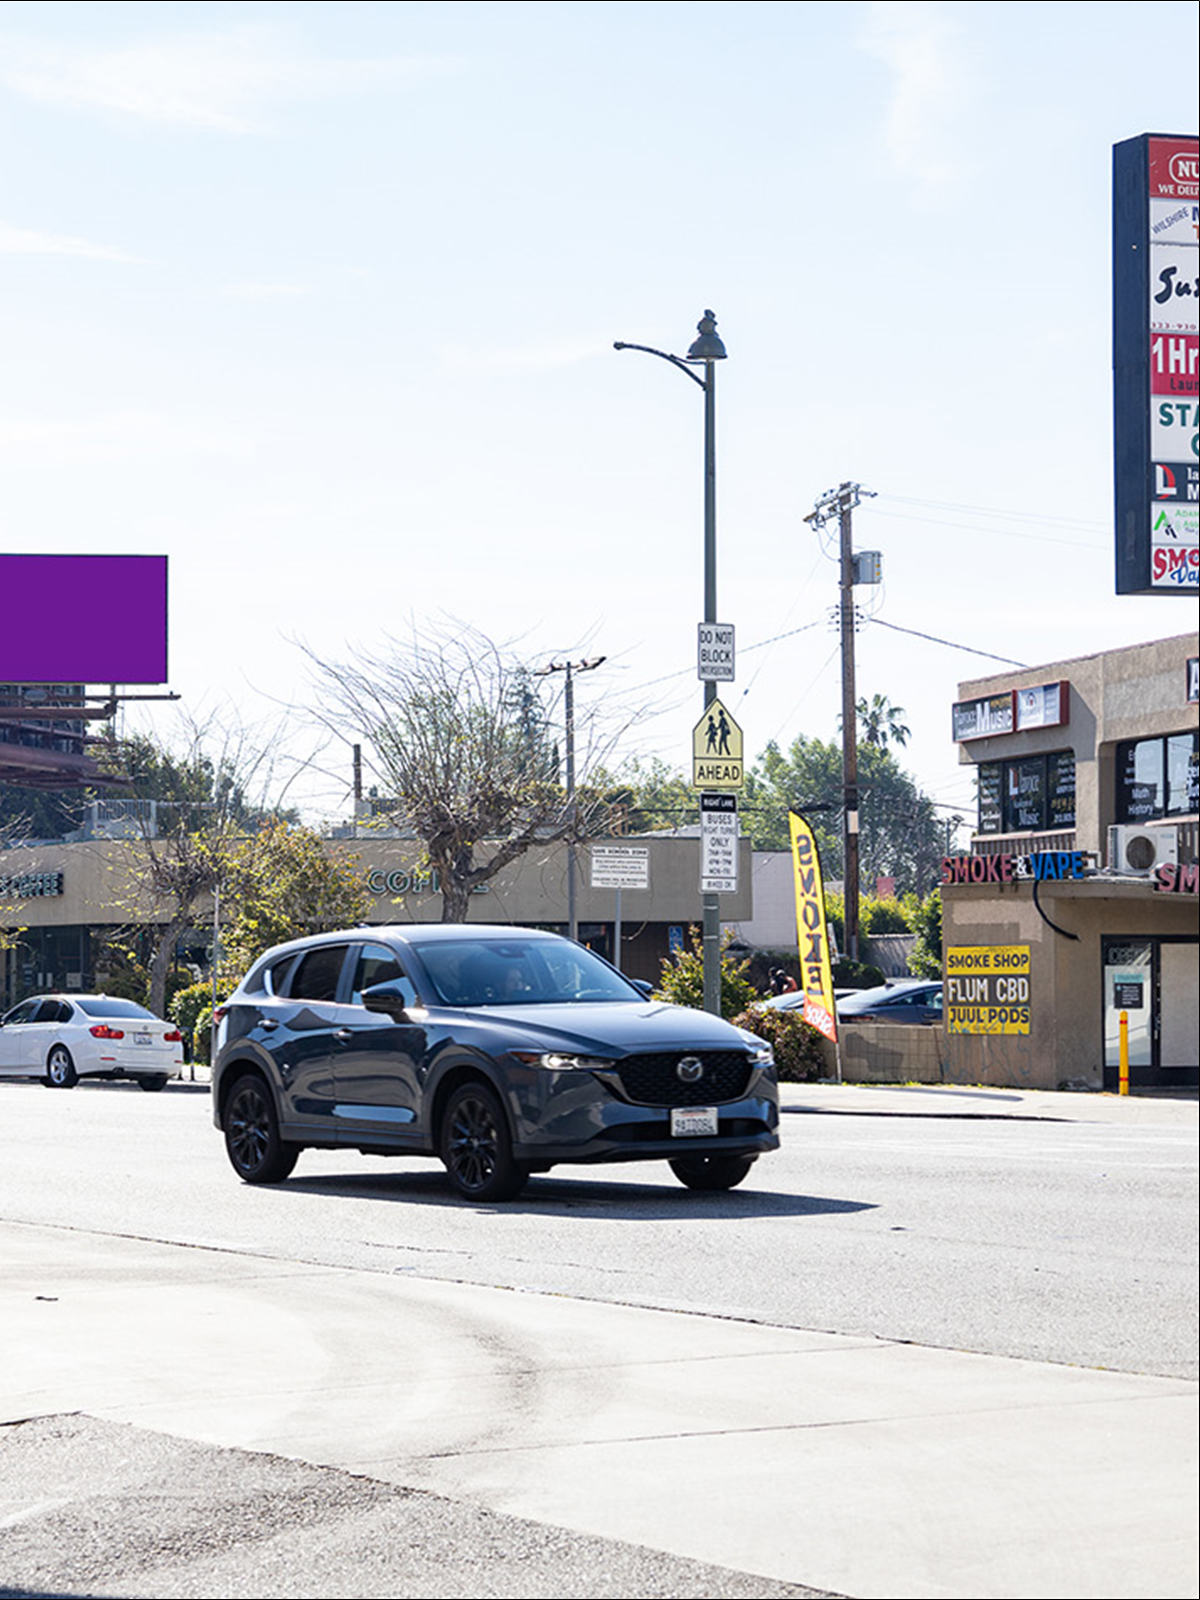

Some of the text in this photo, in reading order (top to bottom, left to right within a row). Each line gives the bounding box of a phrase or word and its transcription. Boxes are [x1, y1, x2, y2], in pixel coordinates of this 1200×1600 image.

[1158, 184, 1174, 194] WE
[1152, 206, 1190, 234] WILSHIRE
[700, 630, 733, 645] DO NOT
[701, 648, 732, 663] BLOCK
[697, 765, 740, 780] AHEAD
[707, 813, 732, 825] BUSES
[709, 837, 730, 847] ONLY
[941, 854, 1013, 883] SMOKE
[1030, 851, 1084, 881] VAPE
[948, 954, 1029, 968] SMOKE SHOP
[947, 978, 1029, 1002] FLUM CBD
[950, 1008, 1029, 1023] JUUL PODS
